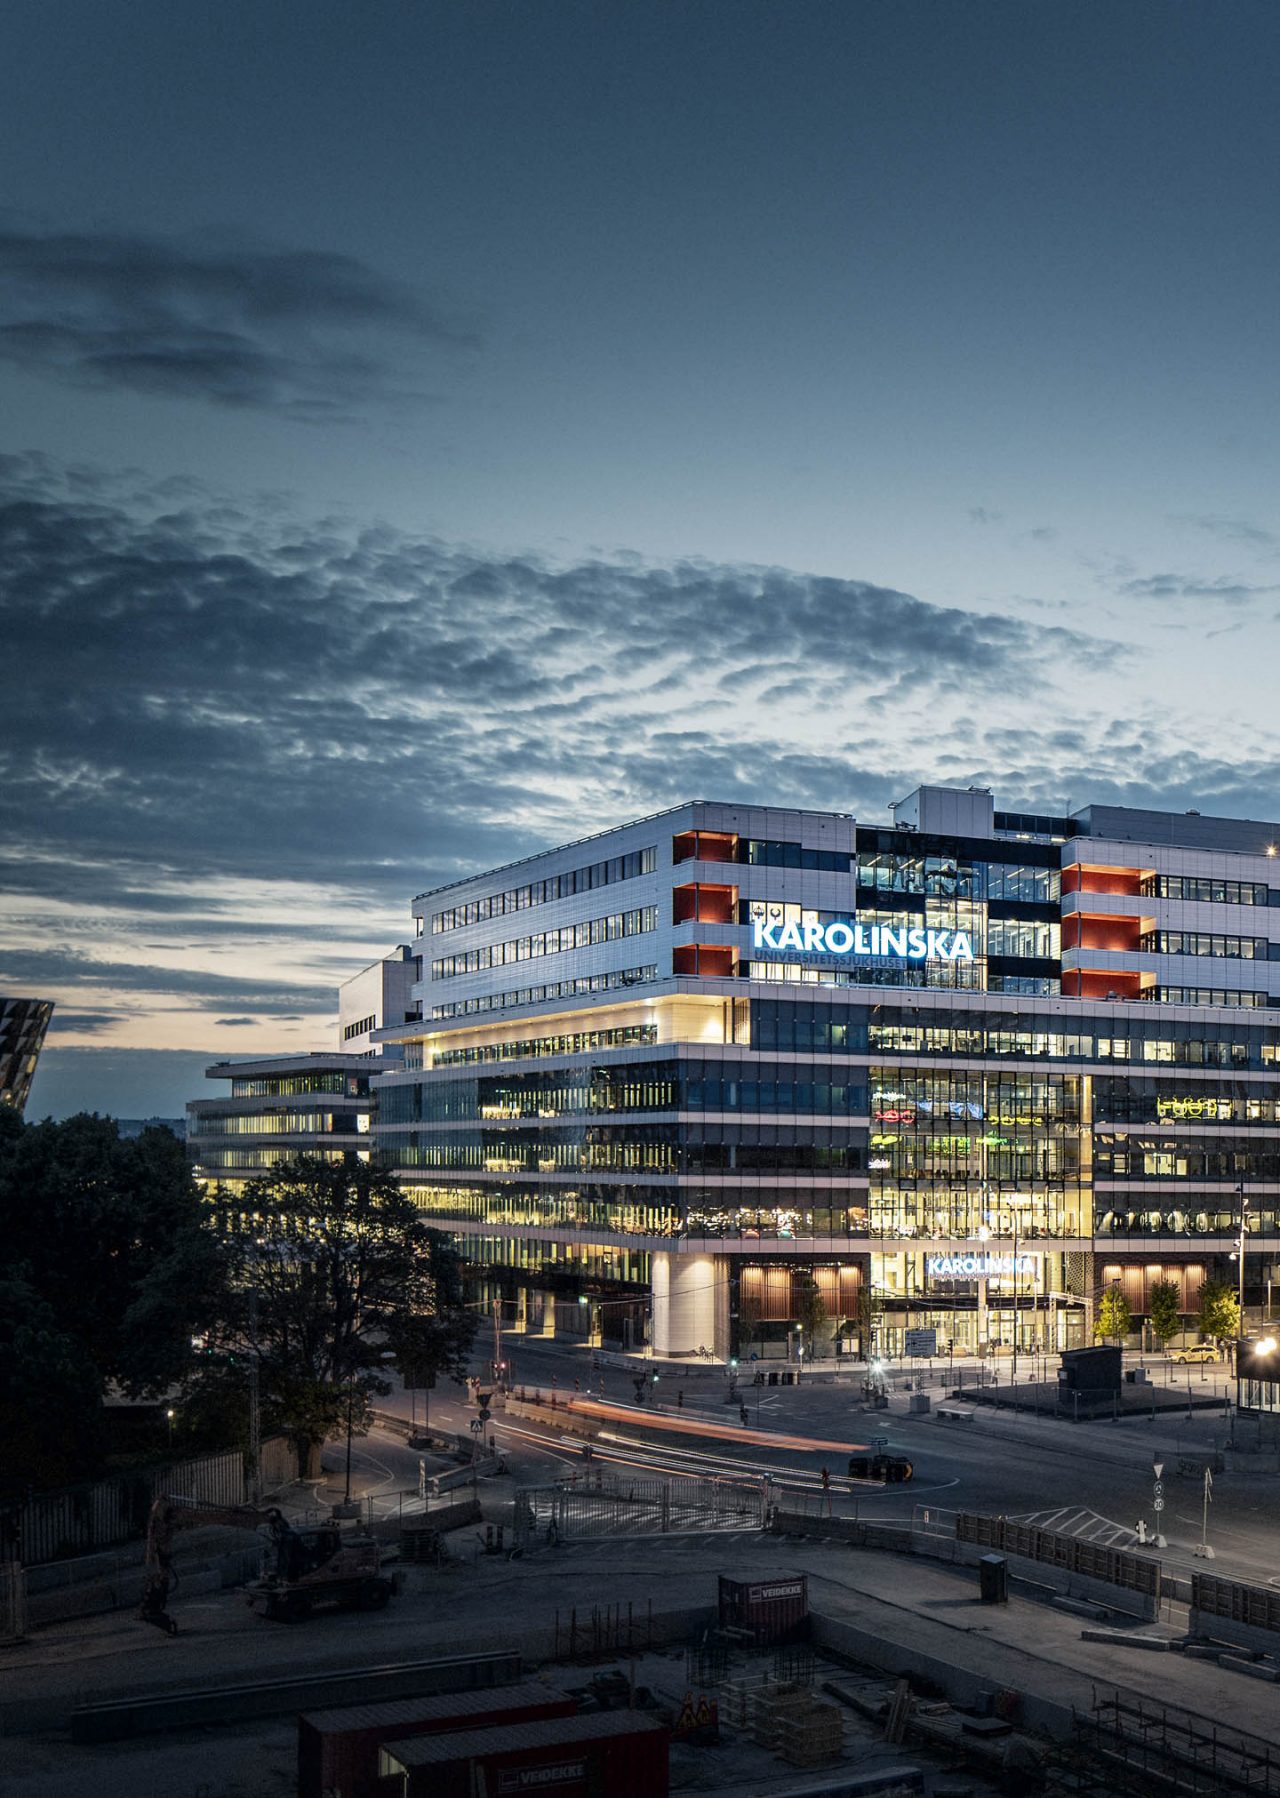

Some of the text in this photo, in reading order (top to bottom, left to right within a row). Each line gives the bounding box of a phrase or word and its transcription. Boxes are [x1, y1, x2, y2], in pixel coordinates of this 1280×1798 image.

[753, 919, 974, 961] KAROLINSKA
[754, 949, 907, 969] UNIVERSITETSSJUKHUSET
[928, 1257, 1035, 1275] KAROLINSKA
[520, 1764, 585, 1785] VEIDEKKE
